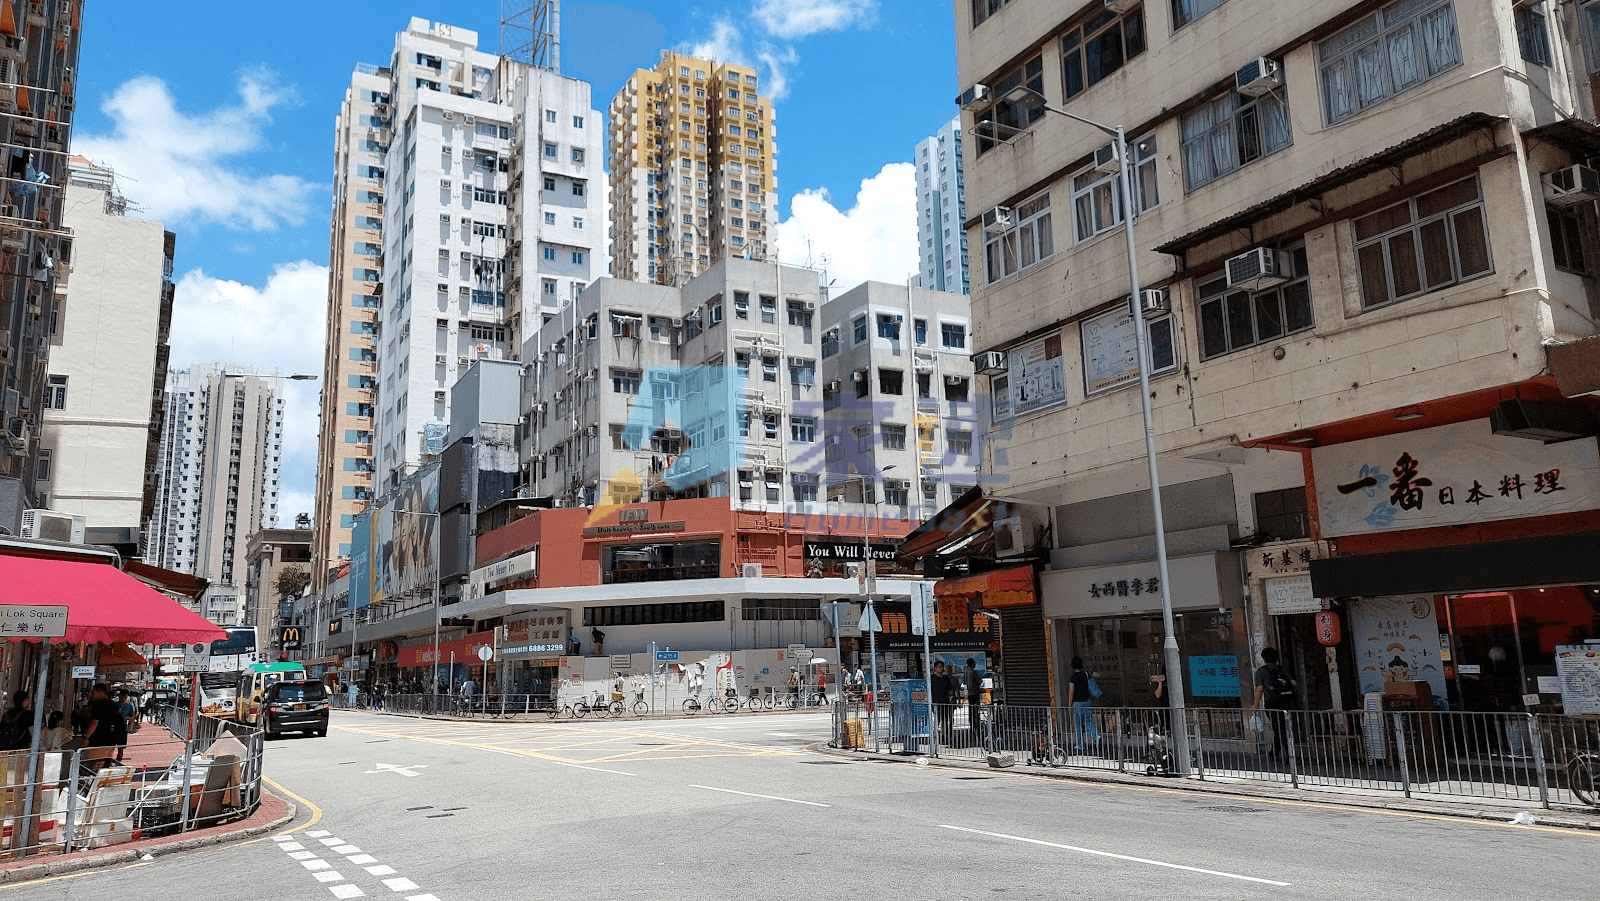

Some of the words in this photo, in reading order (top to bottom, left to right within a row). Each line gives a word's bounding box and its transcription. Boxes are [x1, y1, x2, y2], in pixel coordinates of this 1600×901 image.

[1337, 451, 1566, 511] 一番日本料理
[808, 544, 830, 557] You
[834, 545, 858, 558] Will
[863, 546, 895, 560] Never
[1088, 577, 1160, 598] 女西醫李君
[6, 609, 26, 618] Lok
[29, 609, 65, 619] Square
[1, 622, 45, 633] 仁樂坊
[529, 644, 546, 652] 6886
[546, 643, 563, 652] 3299
